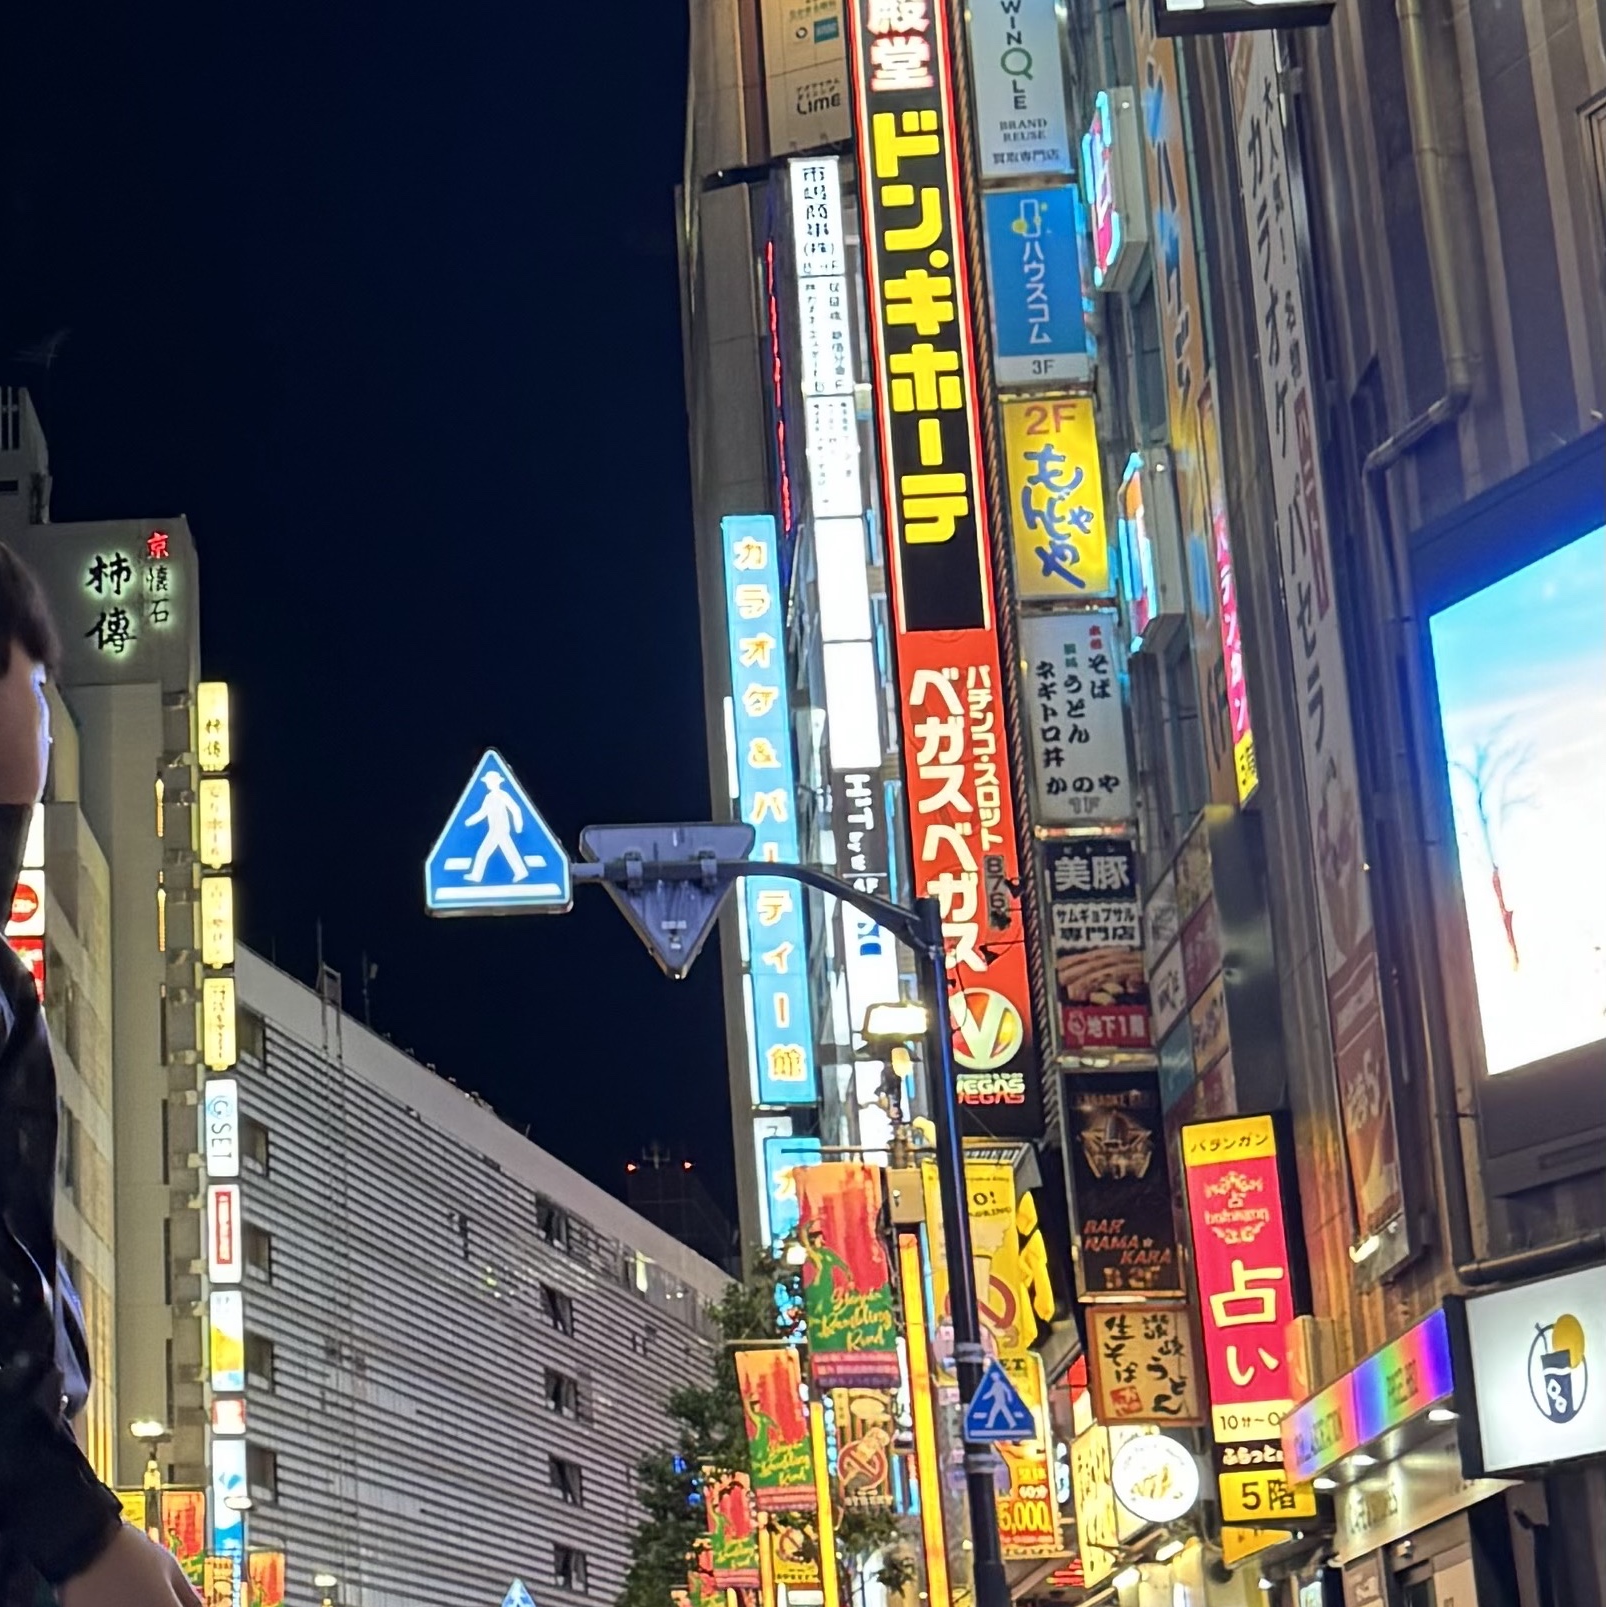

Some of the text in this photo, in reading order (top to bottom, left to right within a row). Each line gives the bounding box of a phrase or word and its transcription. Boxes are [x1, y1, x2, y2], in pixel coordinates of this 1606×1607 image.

[999, 118, 1048, 132] BRAND
[1003, 131, 1046, 143] REUSE
[1021, 241, 1053, 344] ハウスコム
[871, 110, 969, 545] ドン・キホーテ
[1032, 357, 1055, 376] 3F
[1025, 403, 1078, 436] 2F
[1088, 653, 1112, 700] そば
[1063, 673, 1090, 744] うどん
[966, 664, 1003, 852] パチンコ・スロット
[1046, 773, 1120, 795] かのや
[909, 667, 988, 972] ベガスベガス
[1054, 855, 1131, 893] 美豚
[1060, 926, 1135, 942] 専門店
[1209, 1258, 1284, 1387] 占い
[1104, 1314, 1138, 1383] 生そば
[1242, 1480, 1296, 1511] 5階
